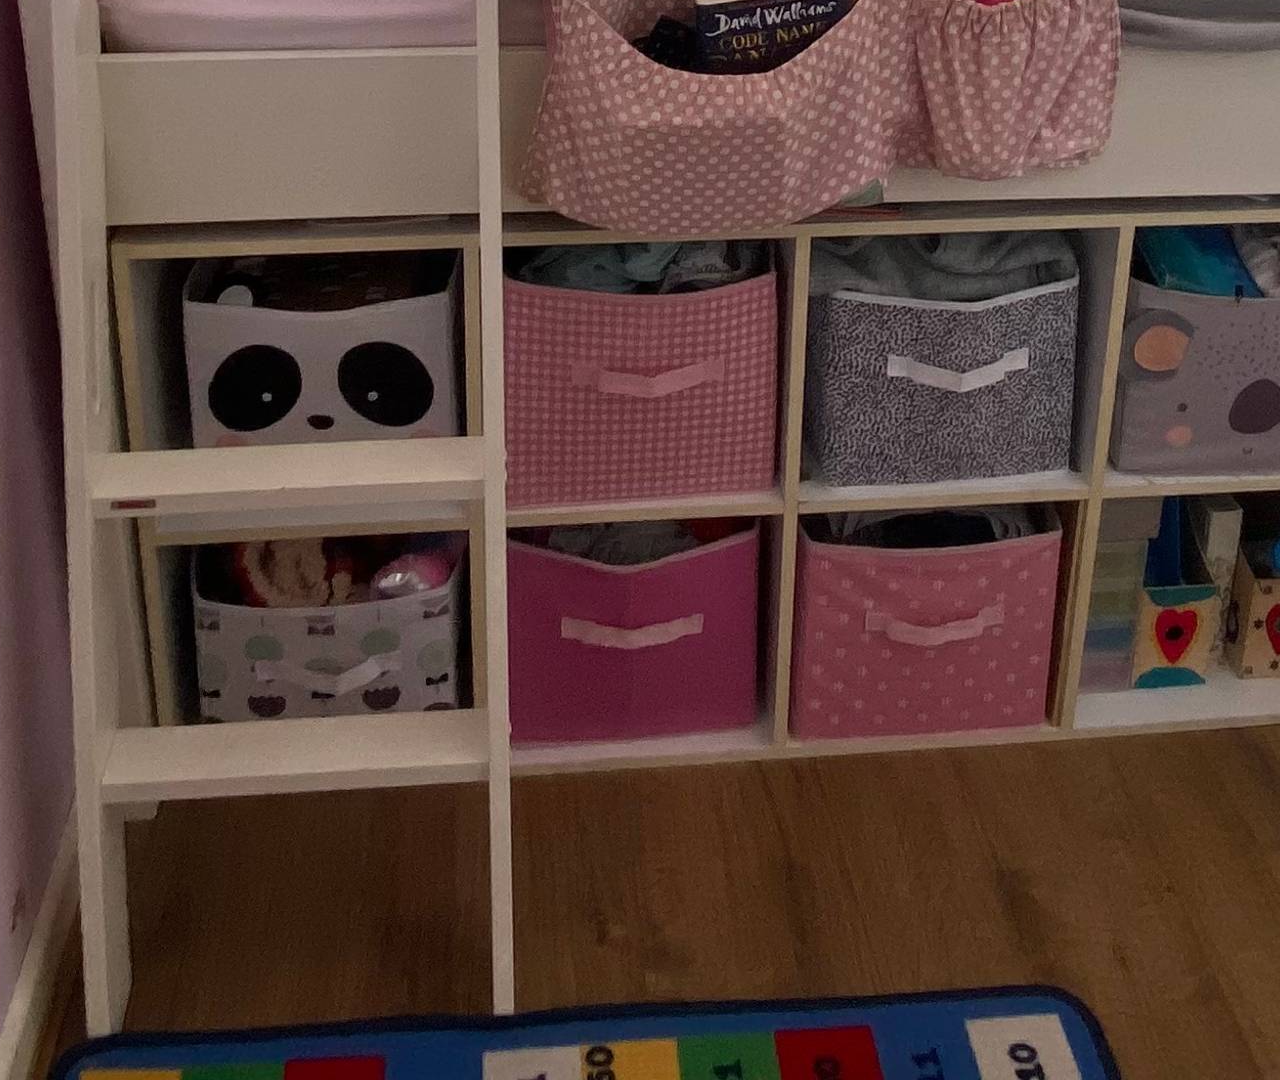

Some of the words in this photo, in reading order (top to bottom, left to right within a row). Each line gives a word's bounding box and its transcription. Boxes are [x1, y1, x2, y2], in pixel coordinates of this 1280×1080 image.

[705, 7, 763, 37] David
[763, 1, 837, 24] Walliams
[1007, 1043, 1045, 1080] 10
